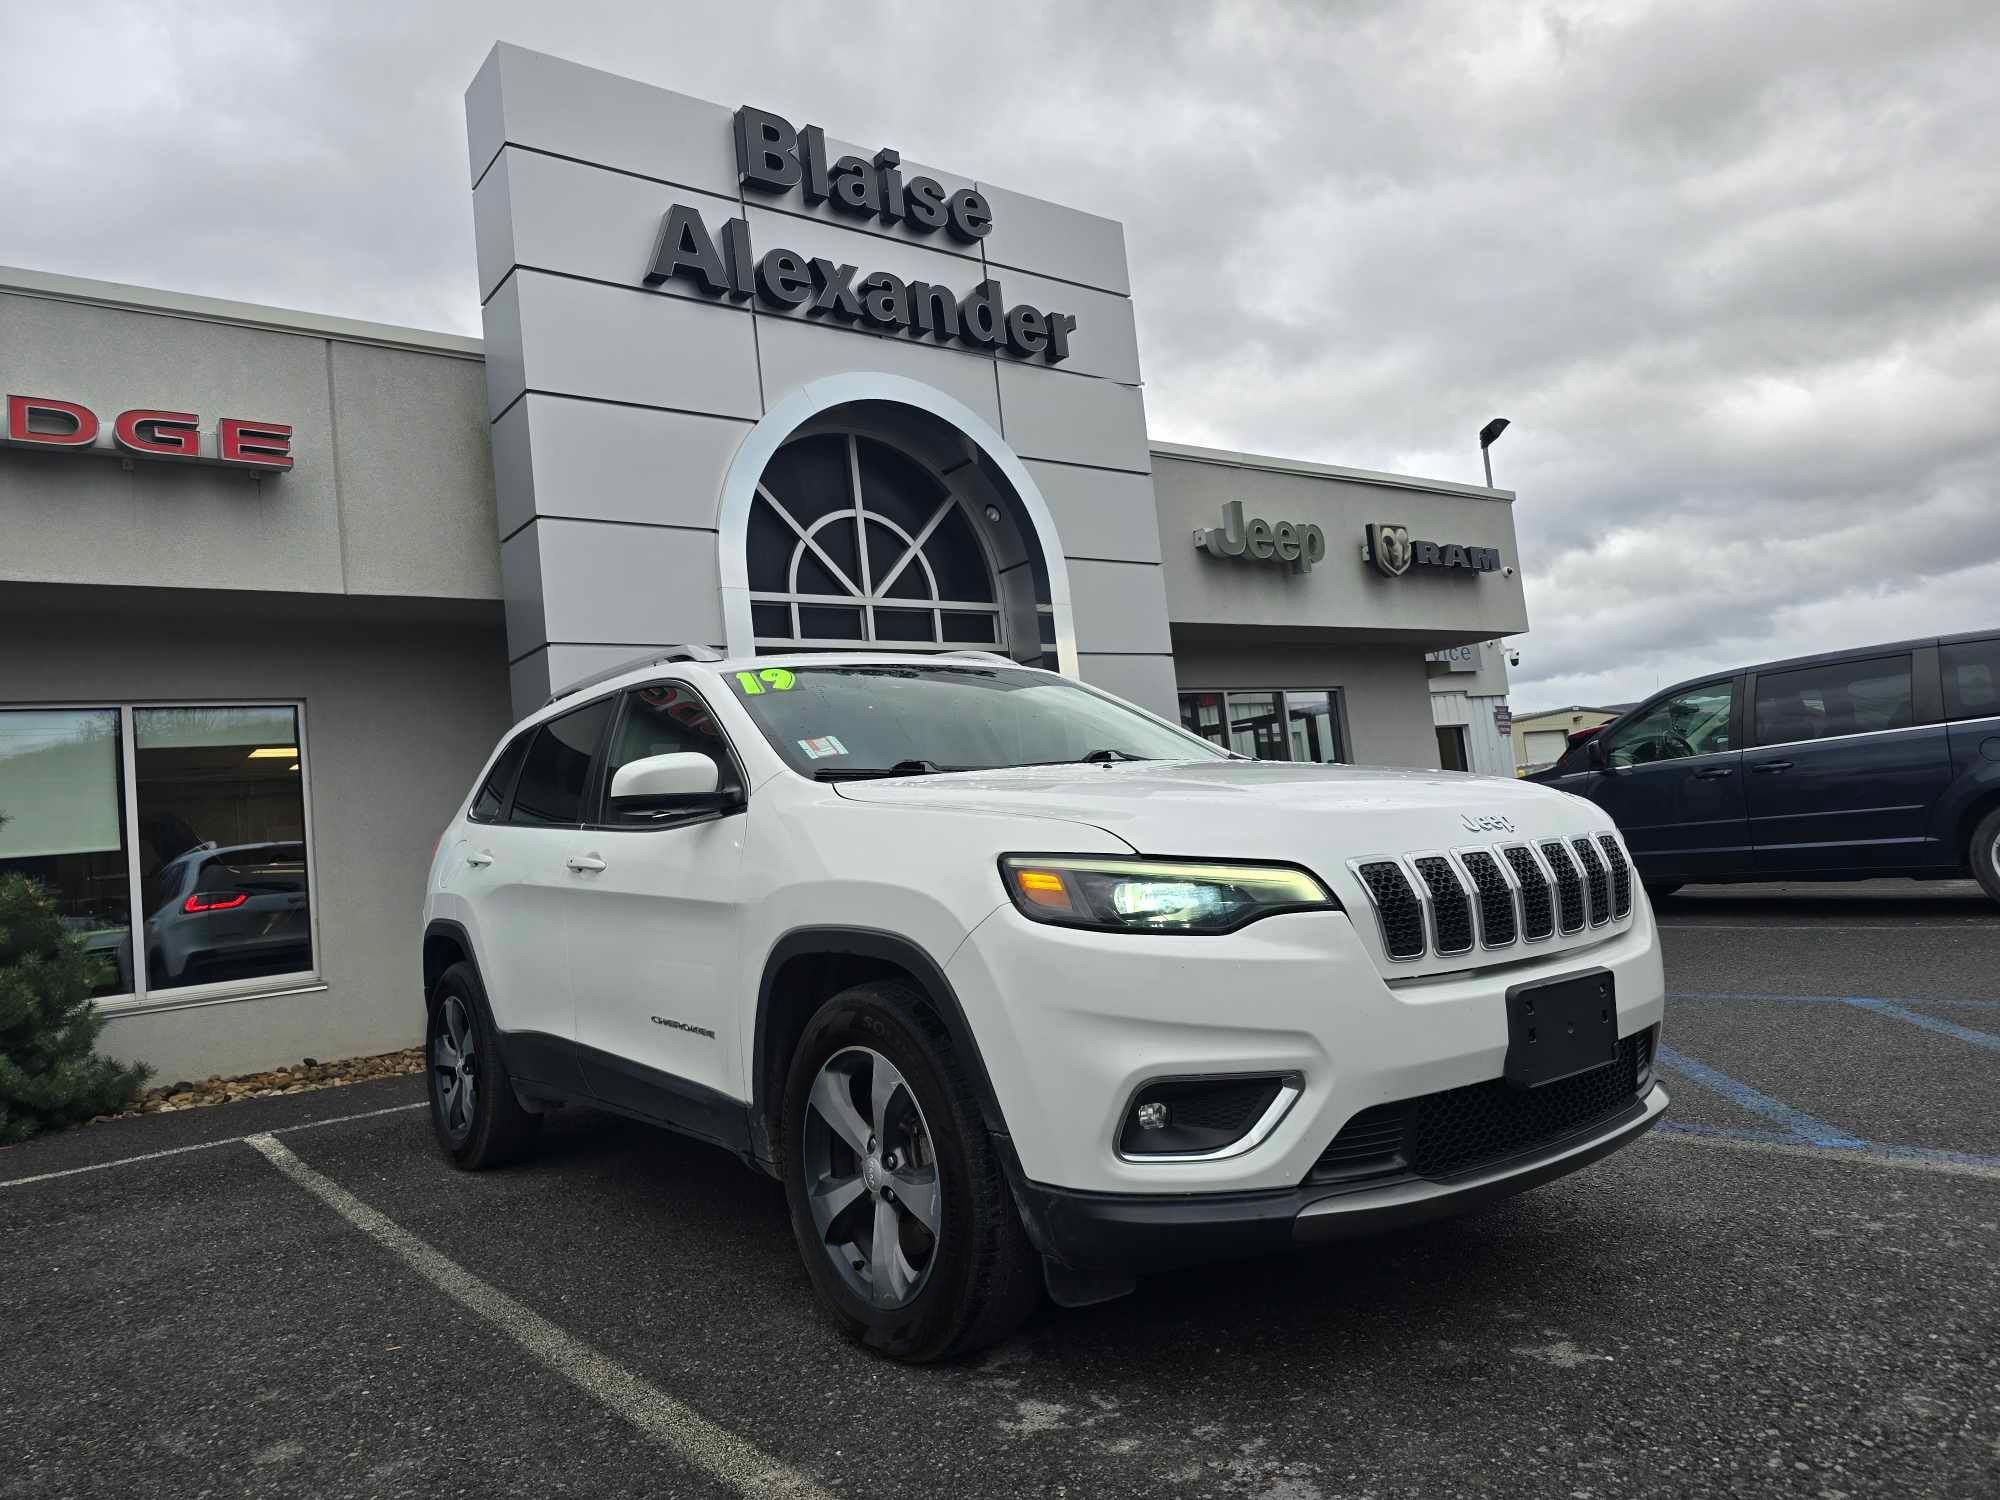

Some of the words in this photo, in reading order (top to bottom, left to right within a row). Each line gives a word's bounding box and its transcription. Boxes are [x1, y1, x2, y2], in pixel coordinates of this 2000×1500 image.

[733, 105, 993, 243] Blaise
[643, 204, 1077, 364] Alexander
[7, 394, 293, 471] DGE
[1205, 500, 1325, 573] Jeep
[1410, 540, 1500, 572] RAM
[736, 669, 796, 695] 19
[1460, 814, 1514, 833] Jeep
